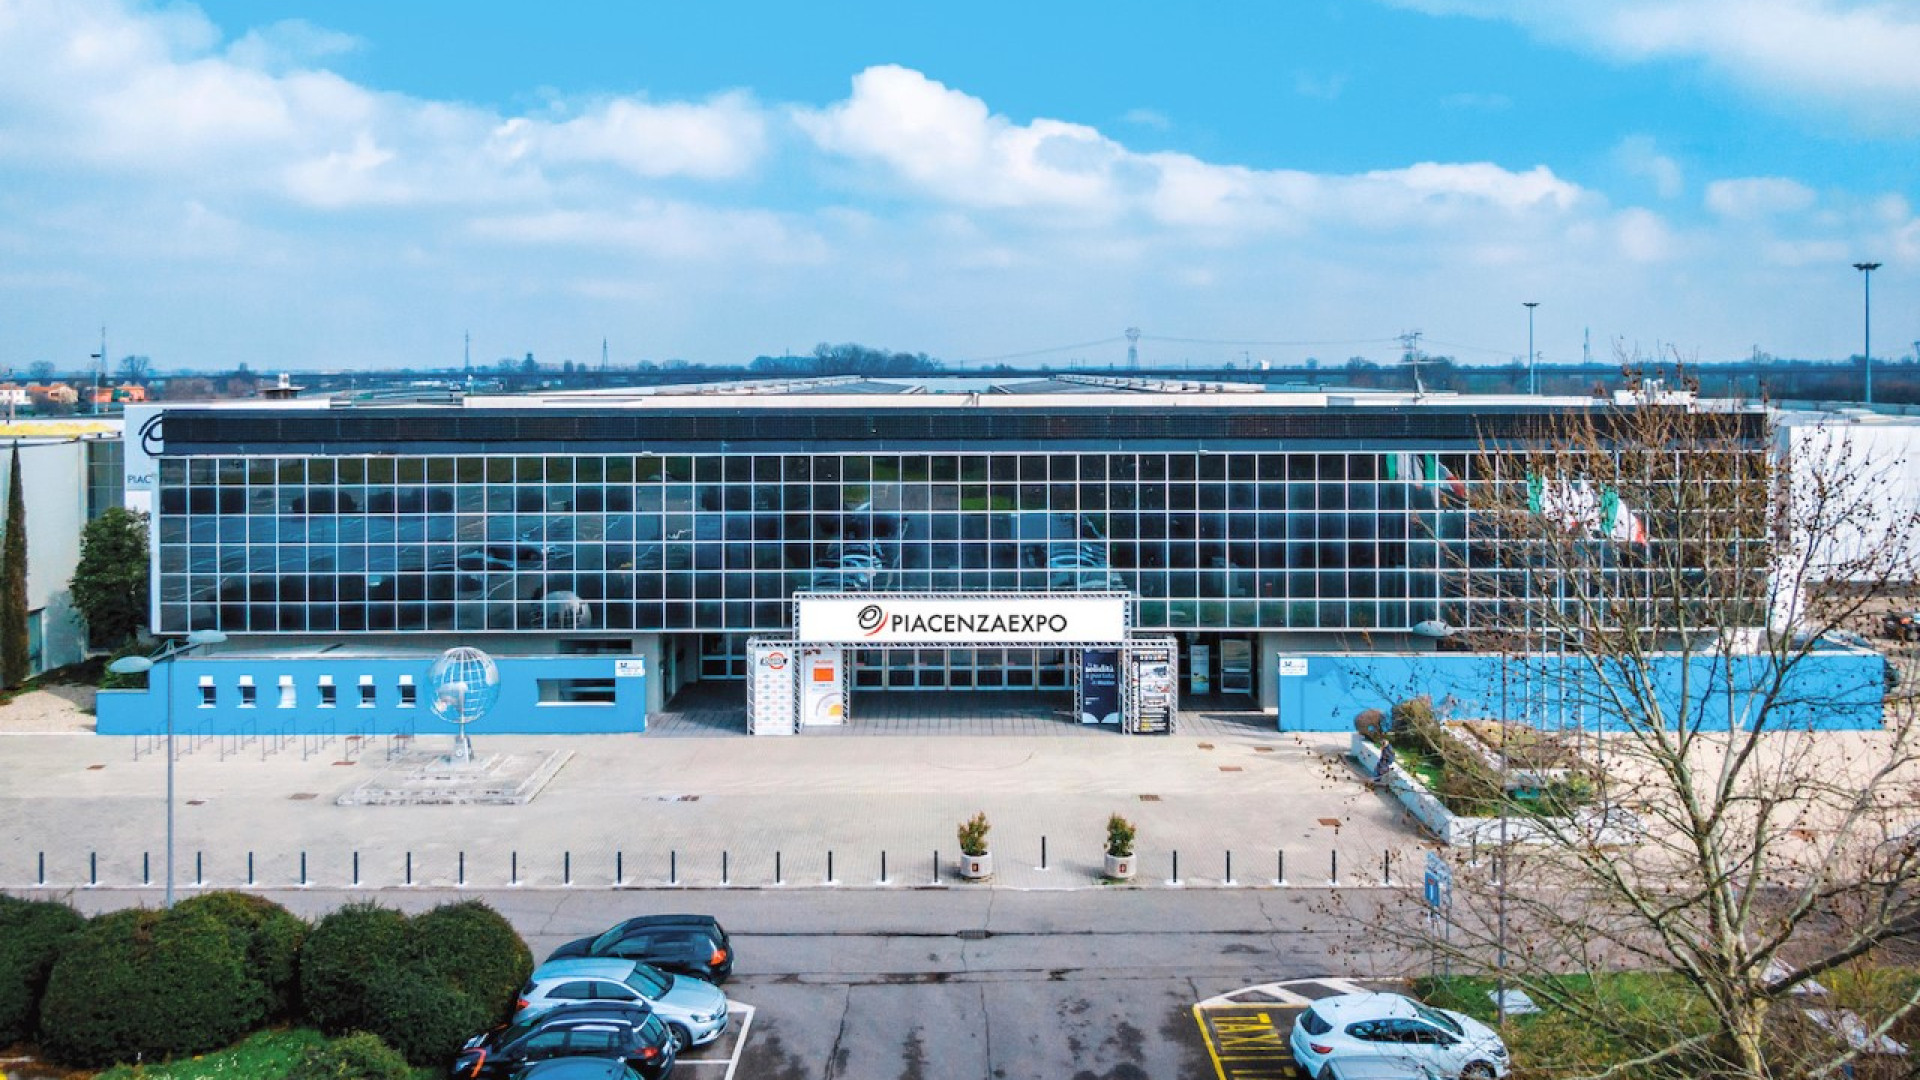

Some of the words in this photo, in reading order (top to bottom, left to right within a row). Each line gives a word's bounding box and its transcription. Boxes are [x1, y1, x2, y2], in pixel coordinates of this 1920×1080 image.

[127, 474, 152, 484] PIAC
[891, 614, 1068, 633] PIACENZAEXPO
[1211, 1013, 1287, 1051] TAXI
